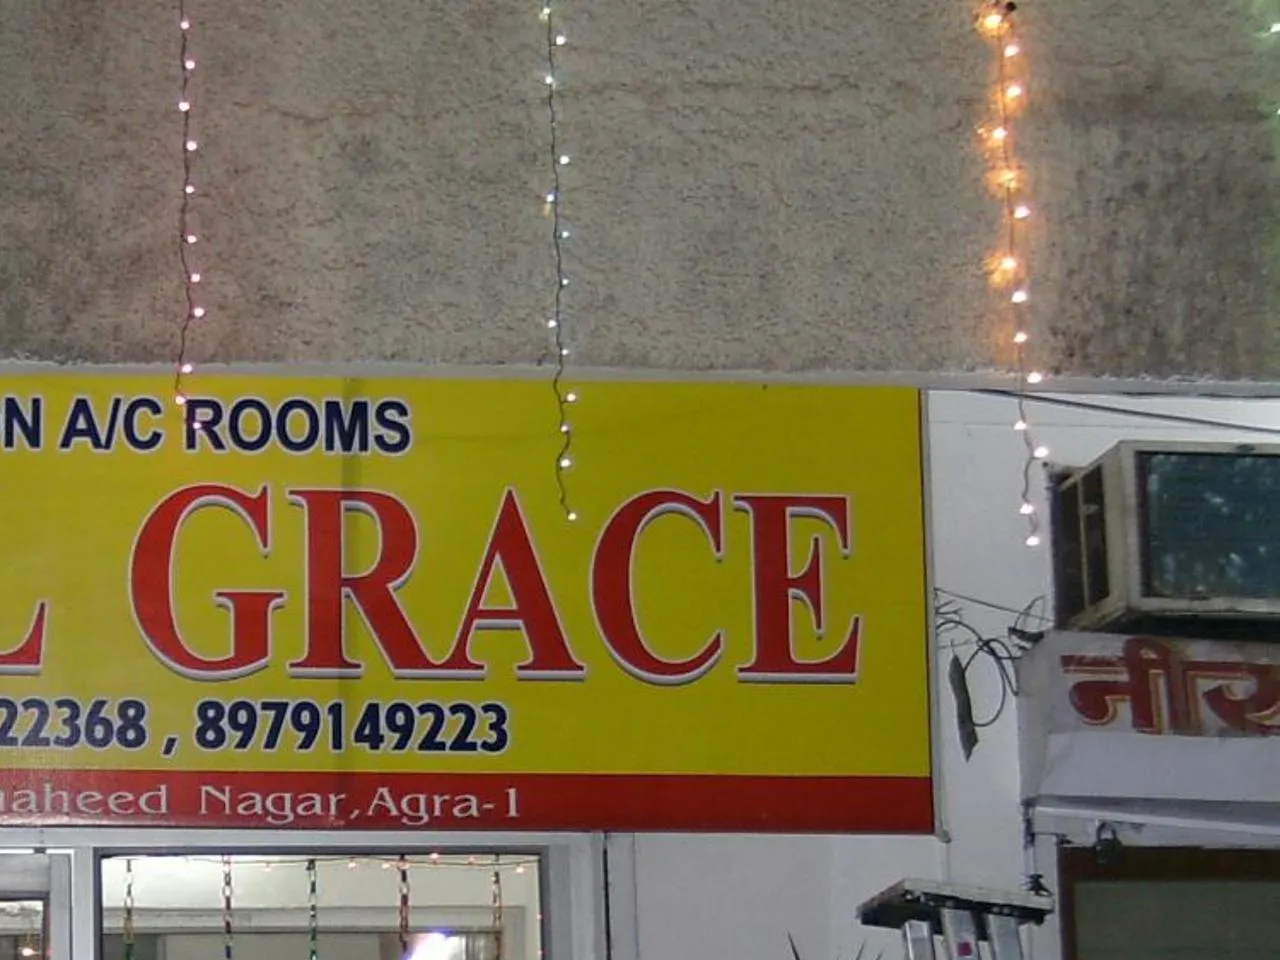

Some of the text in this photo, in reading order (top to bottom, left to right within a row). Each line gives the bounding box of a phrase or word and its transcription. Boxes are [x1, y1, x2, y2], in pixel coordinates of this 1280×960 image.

[58, 396, 164, 451] A/C
[185, 397, 413, 454] ROOMS
[128, 482, 862, 685] GRACE
[194, 700, 510, 753] 8979149223
